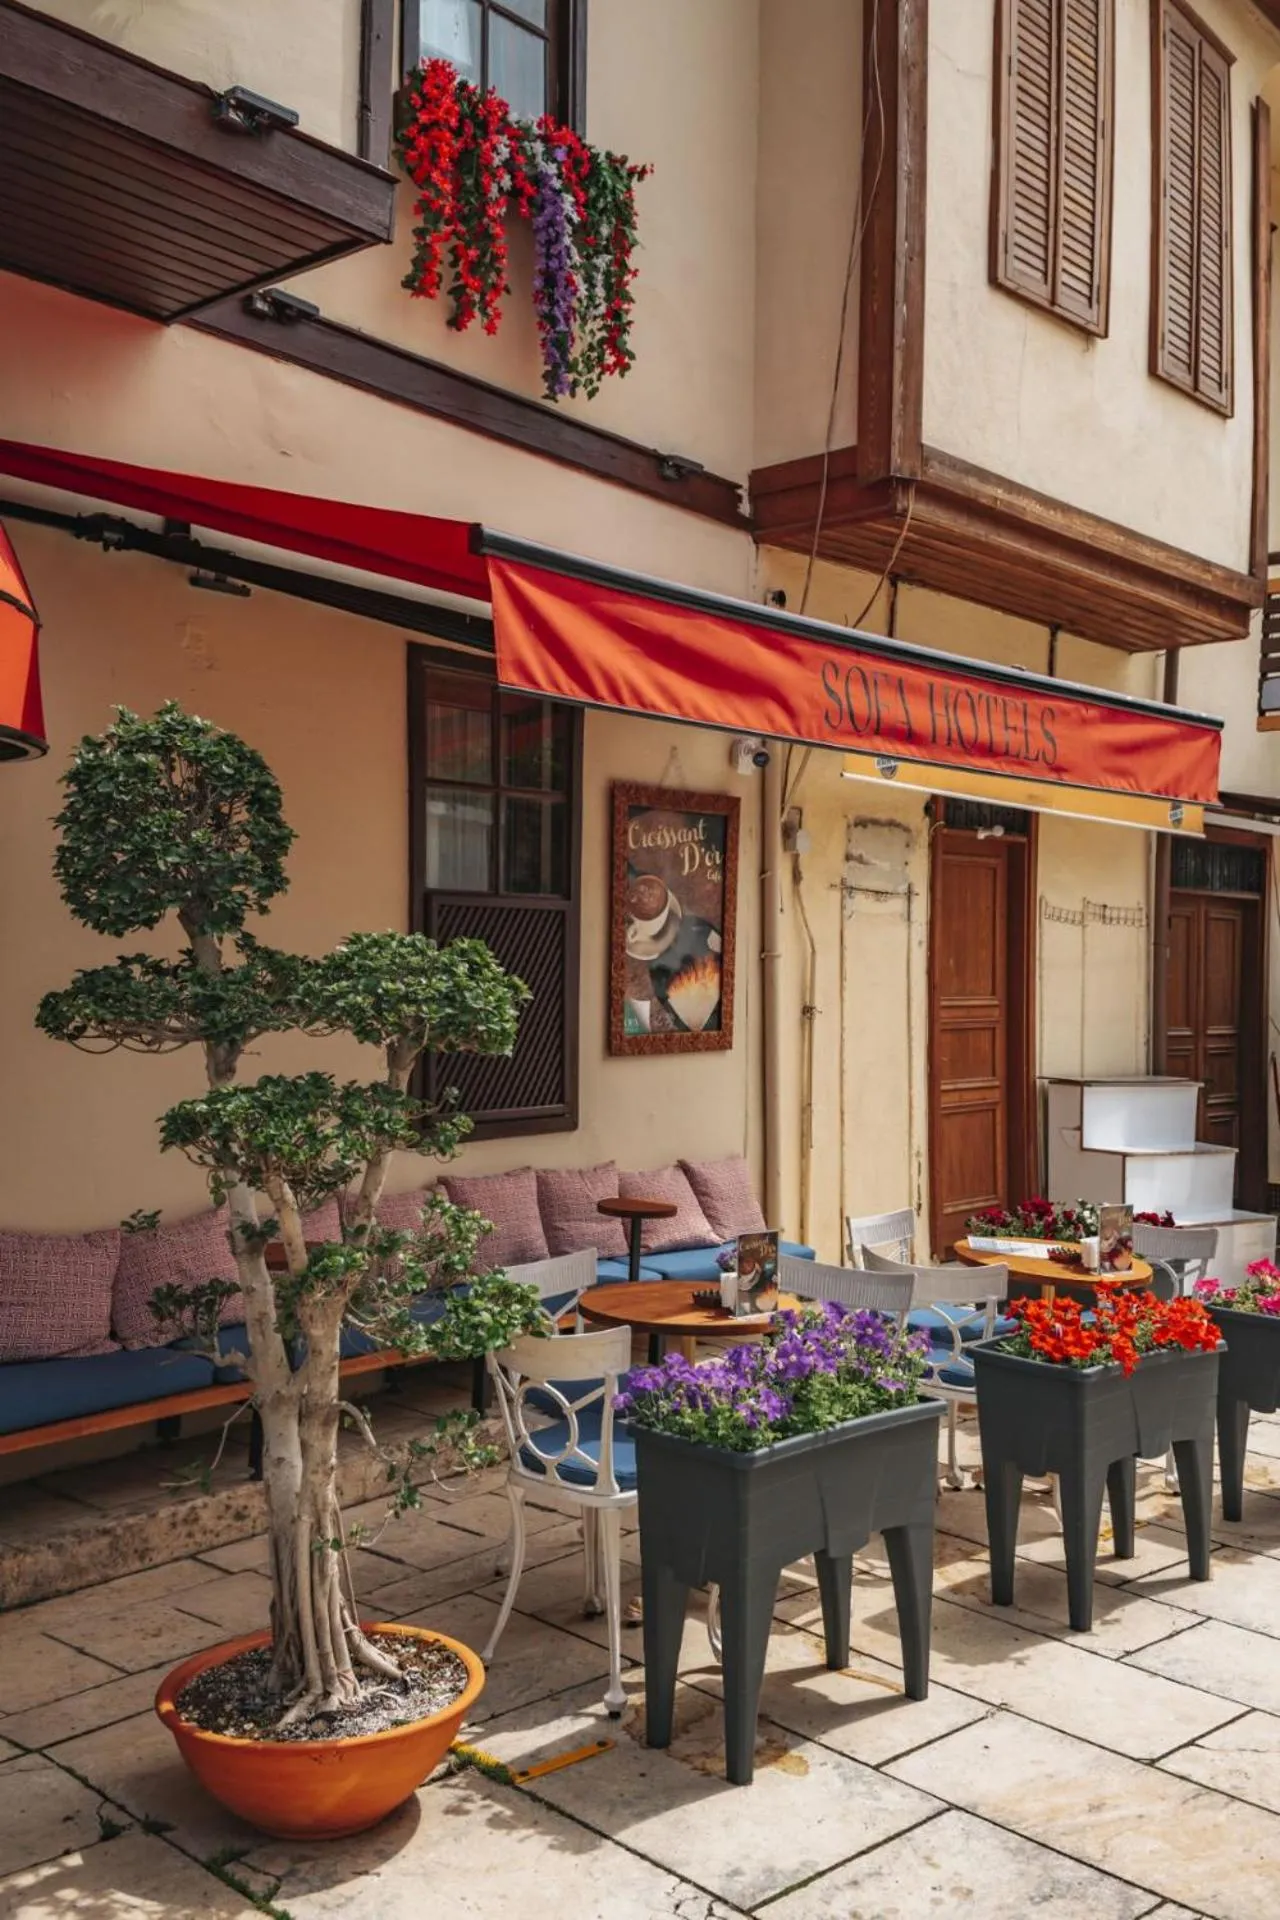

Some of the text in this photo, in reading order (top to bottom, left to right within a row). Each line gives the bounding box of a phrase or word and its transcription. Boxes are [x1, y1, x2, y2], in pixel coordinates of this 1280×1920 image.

[821, 660, 1058, 767] SOFA HOTELS
[628, 818, 708, 850] Croissant
